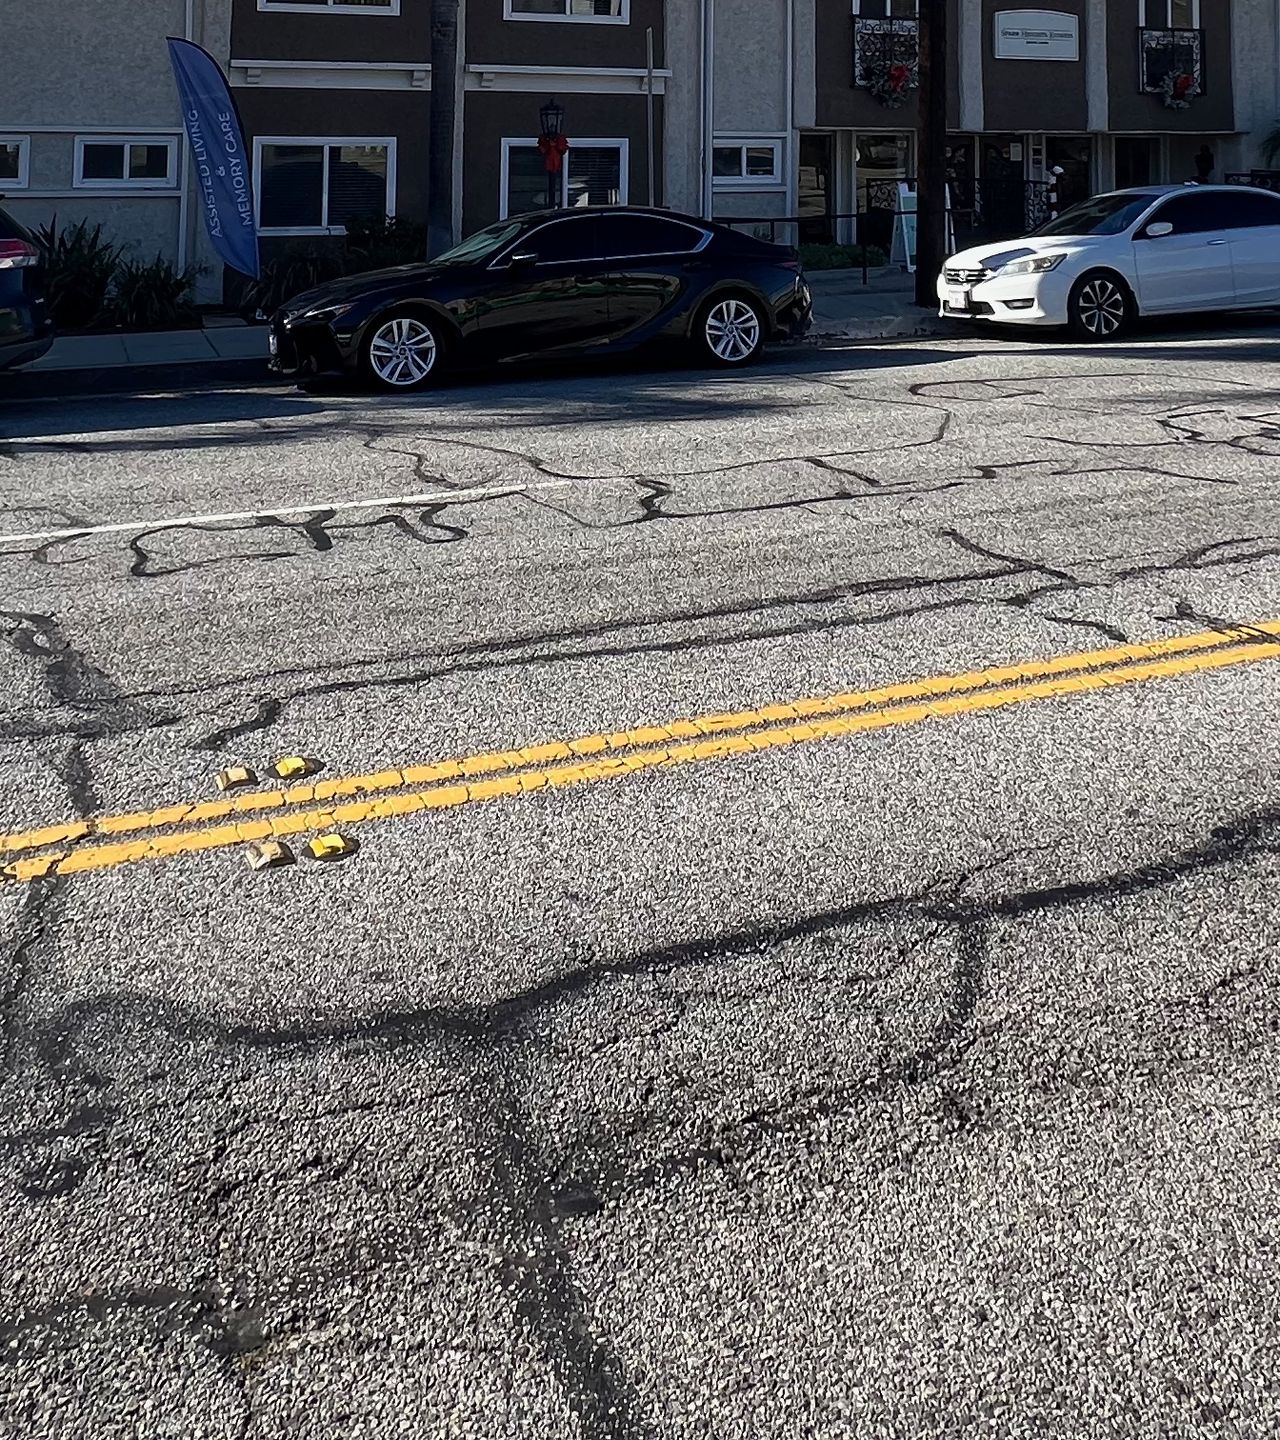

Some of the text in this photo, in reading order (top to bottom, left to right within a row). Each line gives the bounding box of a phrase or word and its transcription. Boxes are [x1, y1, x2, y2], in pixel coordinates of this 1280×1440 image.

[188, 109, 223, 238] ASSISTED LIVING
[215, 165, 226, 177] &
[218, 111, 253, 227] MEMORY CARE
